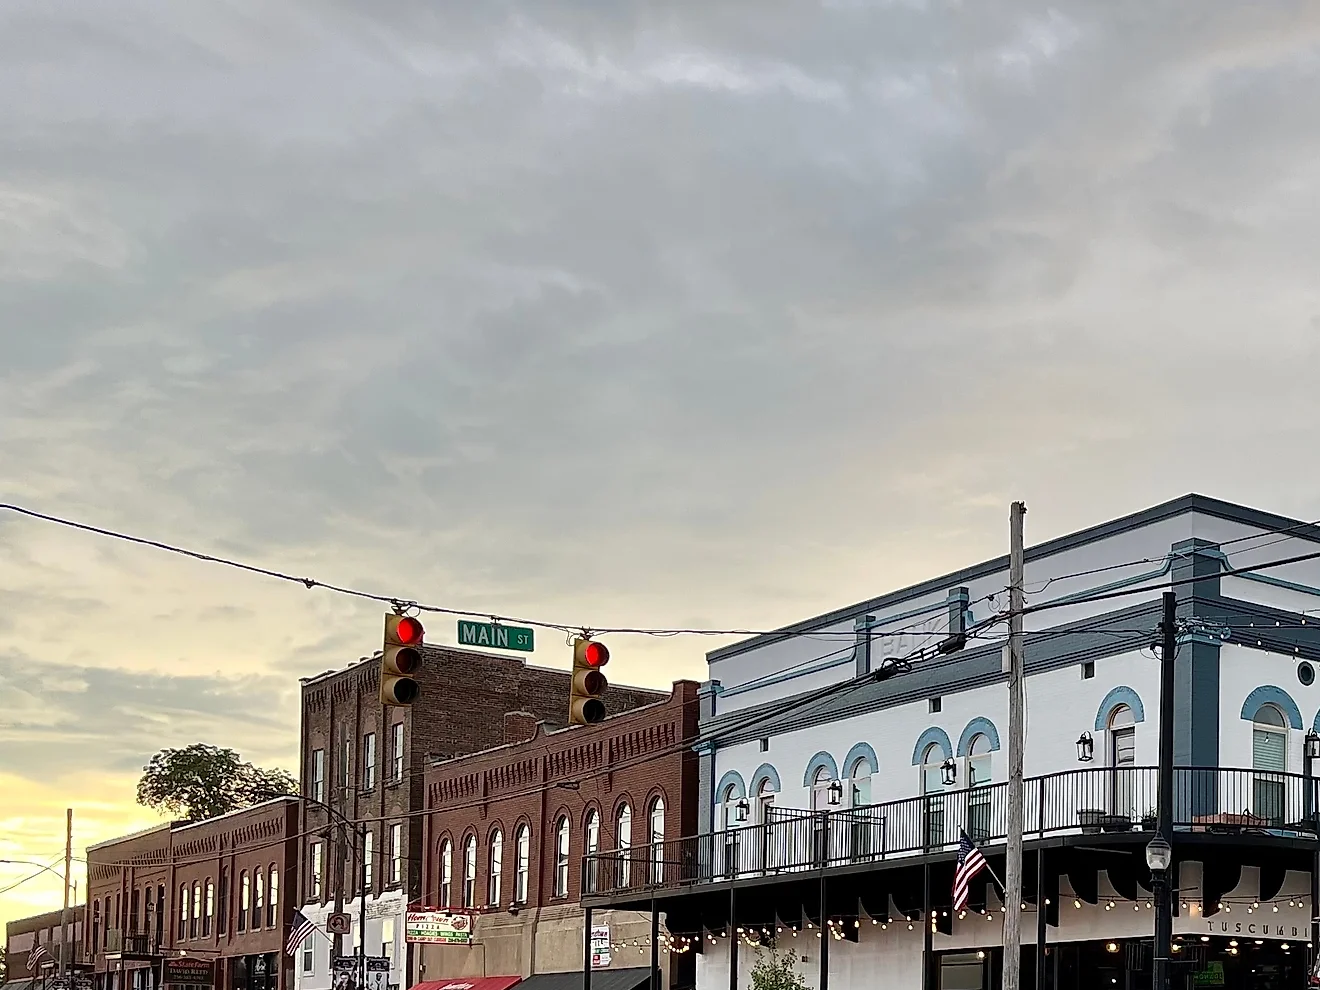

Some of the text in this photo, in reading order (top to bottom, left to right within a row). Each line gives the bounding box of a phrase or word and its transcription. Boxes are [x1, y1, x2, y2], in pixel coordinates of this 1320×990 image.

[462, 623, 529, 647] MAIN ST
[1207, 920, 1308, 938] TUSCUMBI
